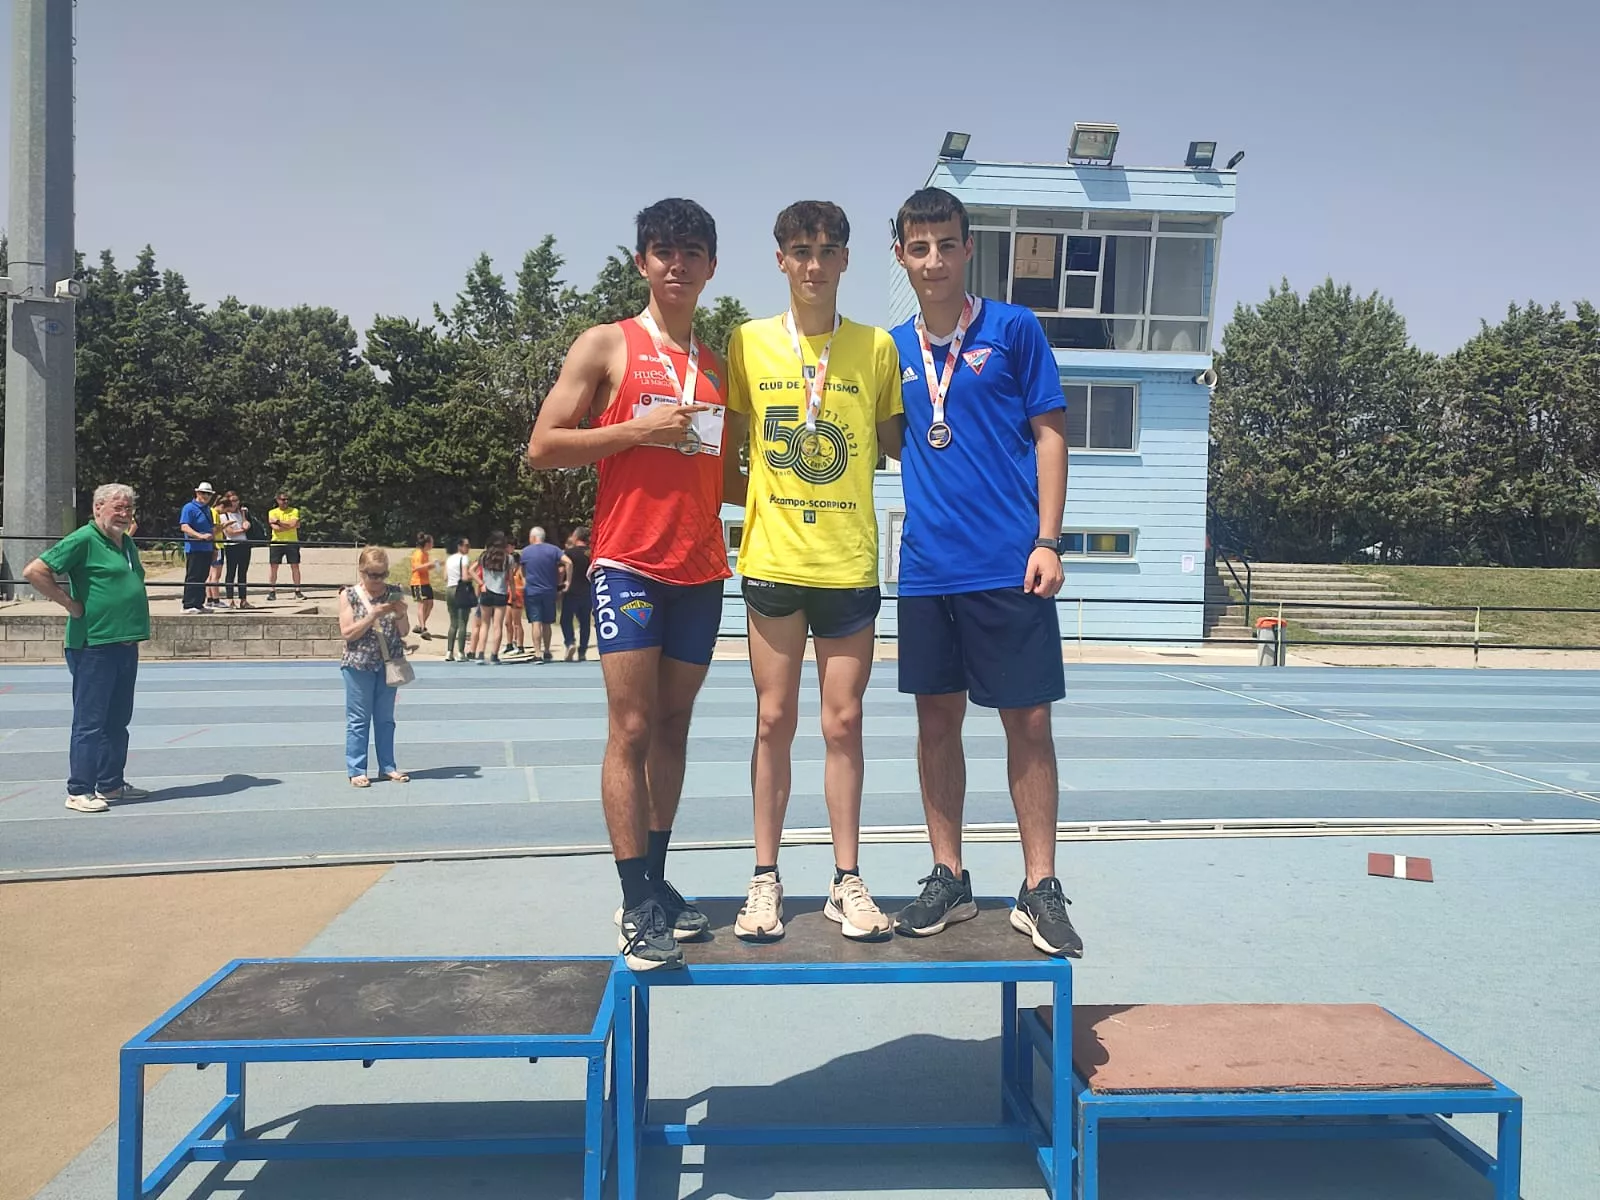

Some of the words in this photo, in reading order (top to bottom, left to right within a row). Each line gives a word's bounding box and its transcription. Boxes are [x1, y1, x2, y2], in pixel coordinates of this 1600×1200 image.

[759, 381, 783, 391] CLUB
[786, 381, 801, 390] DE
[802, 382, 860, 394] ETISMO
[764, 406, 848, 484] 50
